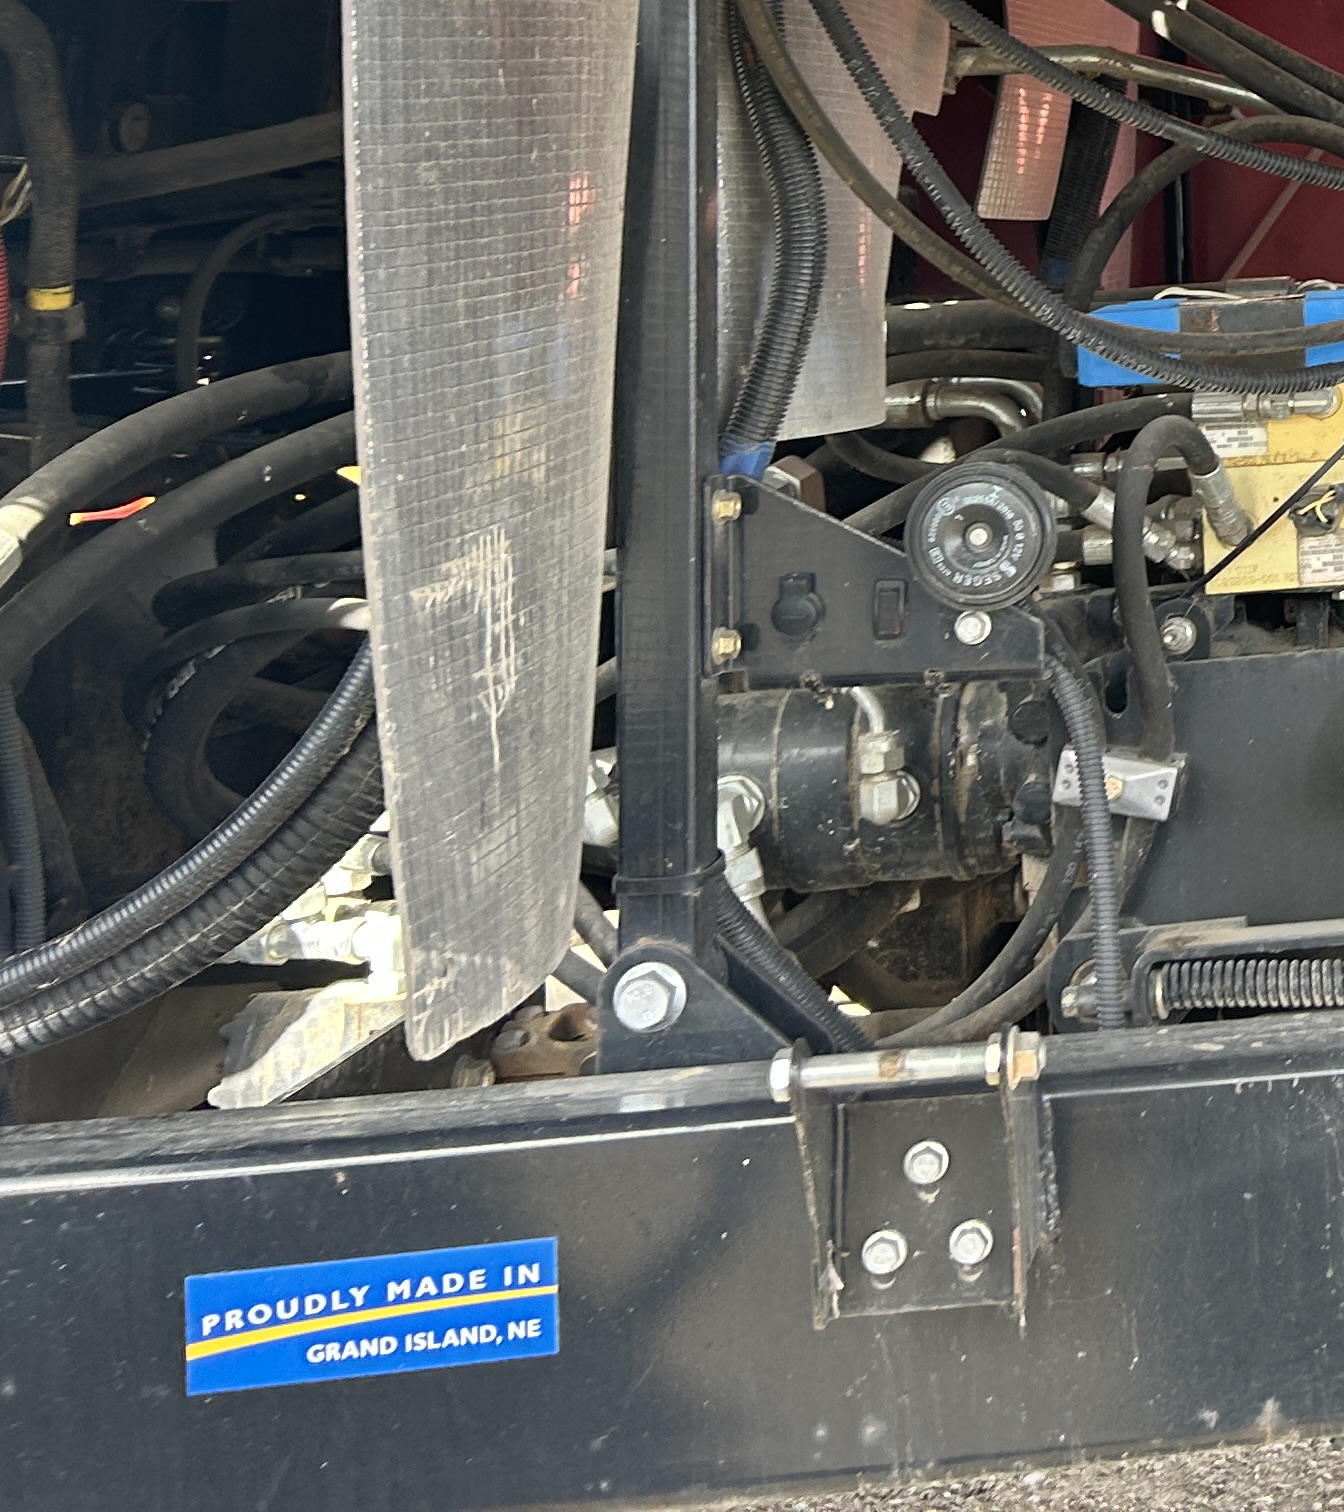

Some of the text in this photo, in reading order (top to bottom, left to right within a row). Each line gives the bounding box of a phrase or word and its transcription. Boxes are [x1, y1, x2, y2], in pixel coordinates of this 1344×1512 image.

[200, 1262, 542, 1337] PROUDLY MADE IN
[305, 1318, 542, 1364] GRAND ISLAND, NE
